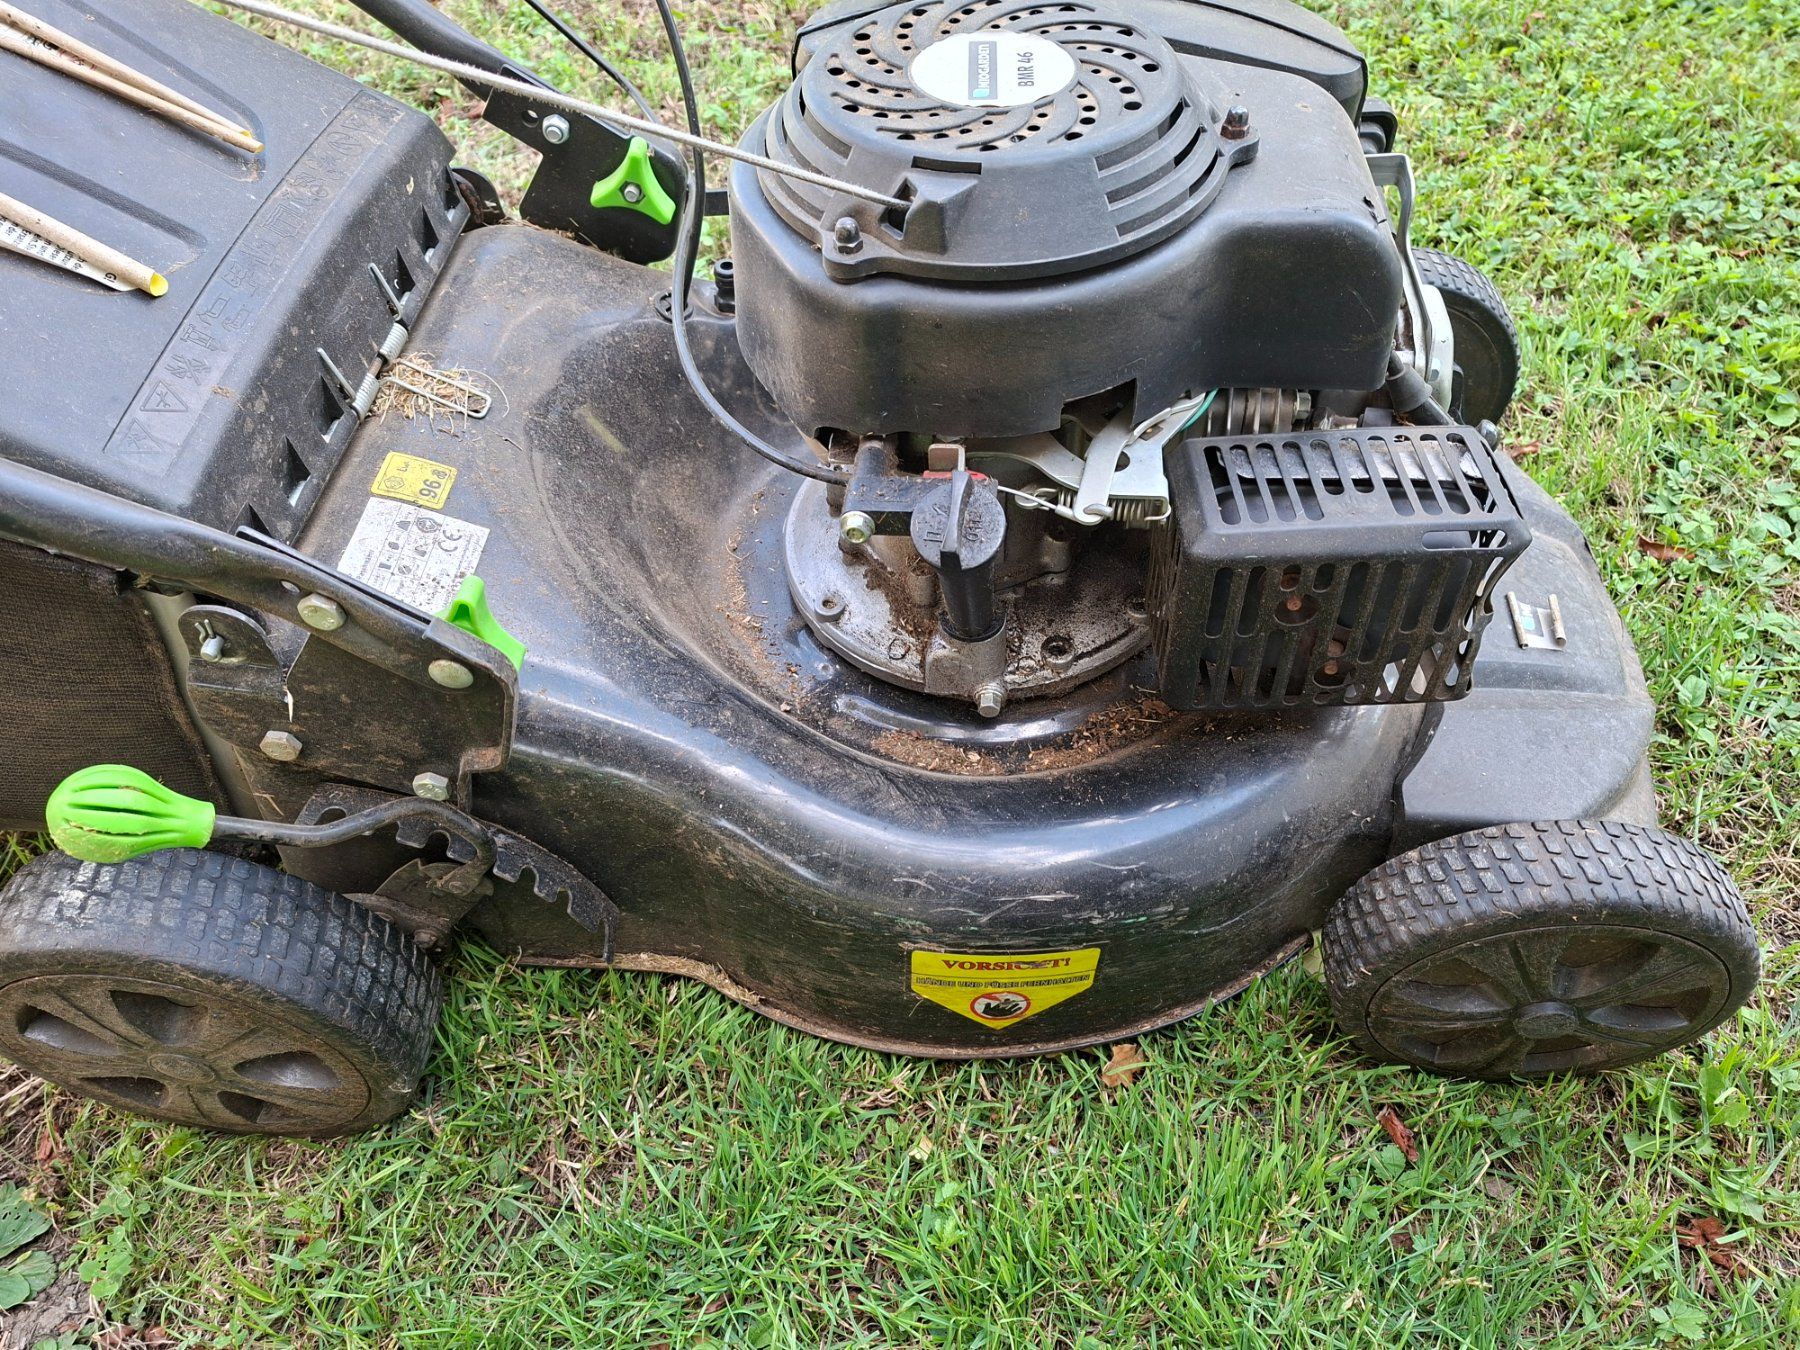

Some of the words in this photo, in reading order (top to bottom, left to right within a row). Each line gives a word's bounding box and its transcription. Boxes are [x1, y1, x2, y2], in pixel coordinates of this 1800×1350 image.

[1016, 51, 1034, 63] 46
[977, 43, 990, 90] MIOGARDEN
[1017, 65, 1035, 87] BMR
[419, 479, 442, 499] 96
[942, 957, 1071, 971] VORSICT!
[957, 980, 983, 989] UND
